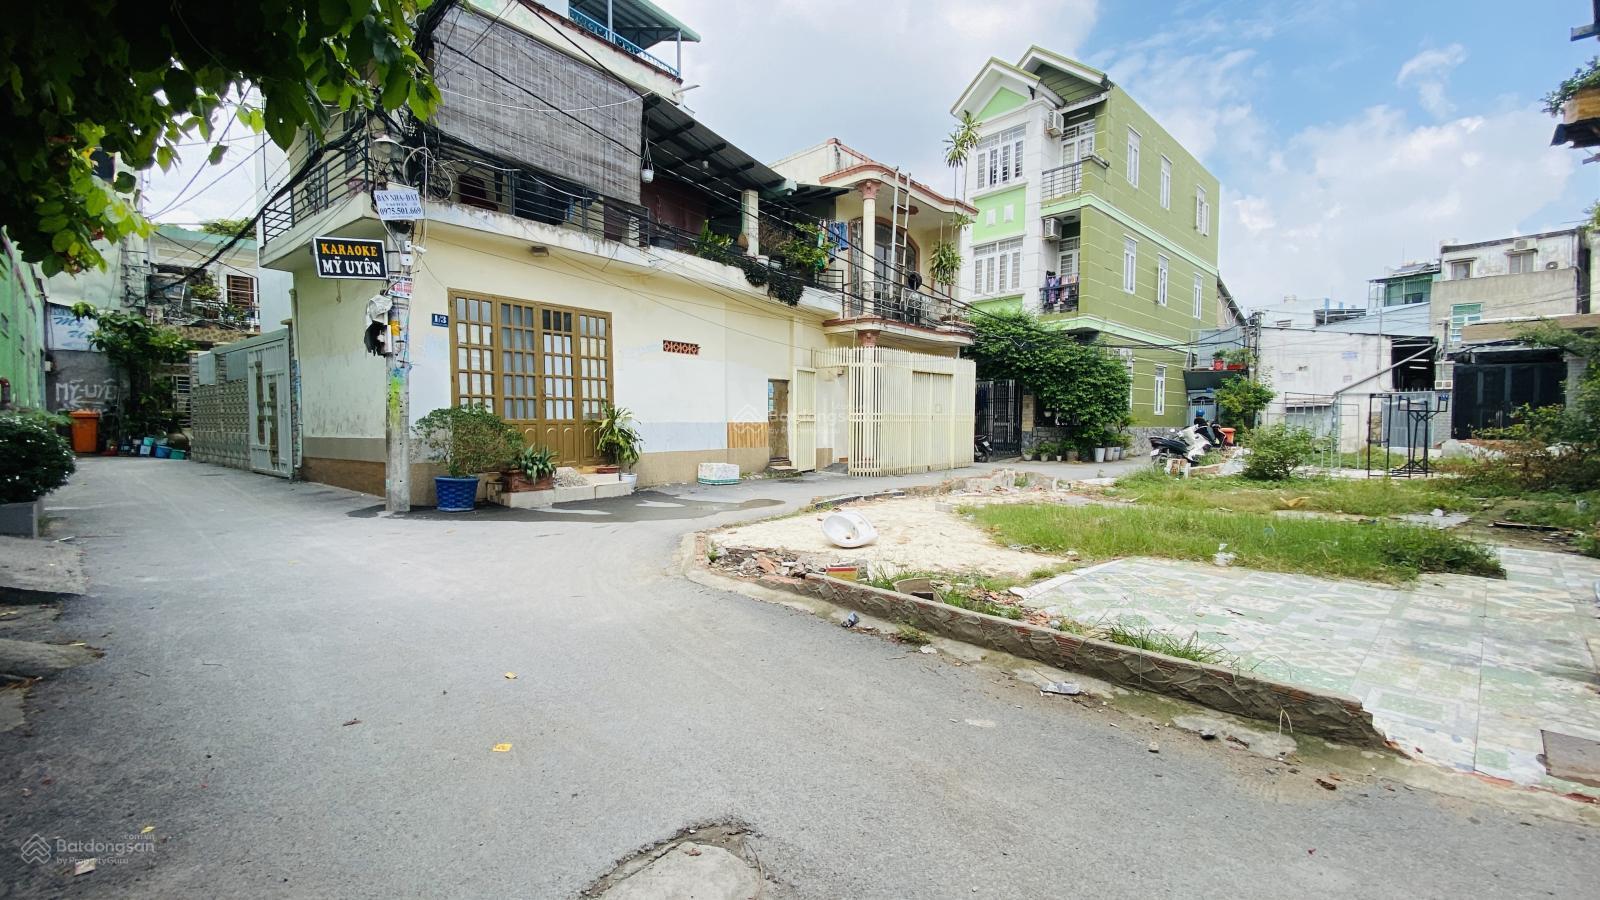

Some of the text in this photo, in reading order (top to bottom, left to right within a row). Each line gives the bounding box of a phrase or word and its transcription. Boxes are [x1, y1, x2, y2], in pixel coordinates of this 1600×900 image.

[321, 243, 378, 257] KARAOKE
[322, 256, 381, 275] MỸ UYÊN
[434, 314, 447, 324] 1/3
